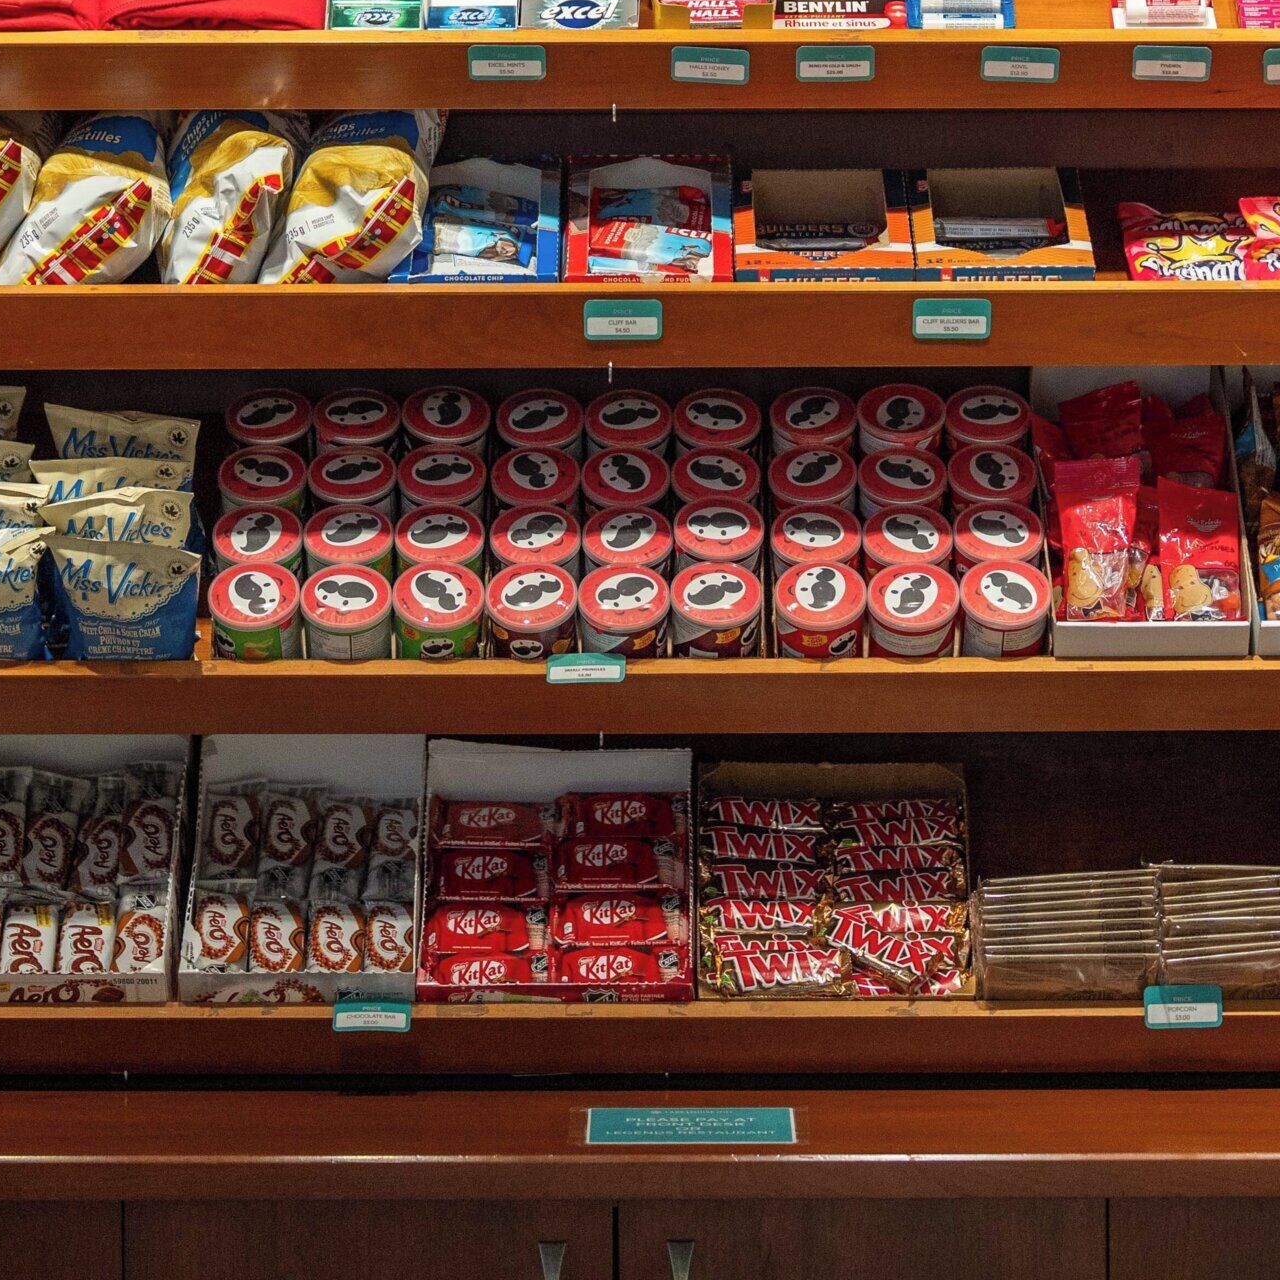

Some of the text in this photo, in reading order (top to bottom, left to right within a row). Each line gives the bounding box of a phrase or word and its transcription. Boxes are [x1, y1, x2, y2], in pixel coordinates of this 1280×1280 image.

[540, 0, 618, 20] excel
[690, 9, 740, 17] HALLS
[784, 2, 866, 13] BENYLIN
[322, 920, 343, 954] Aero
[378, 920, 398, 953] Aero
